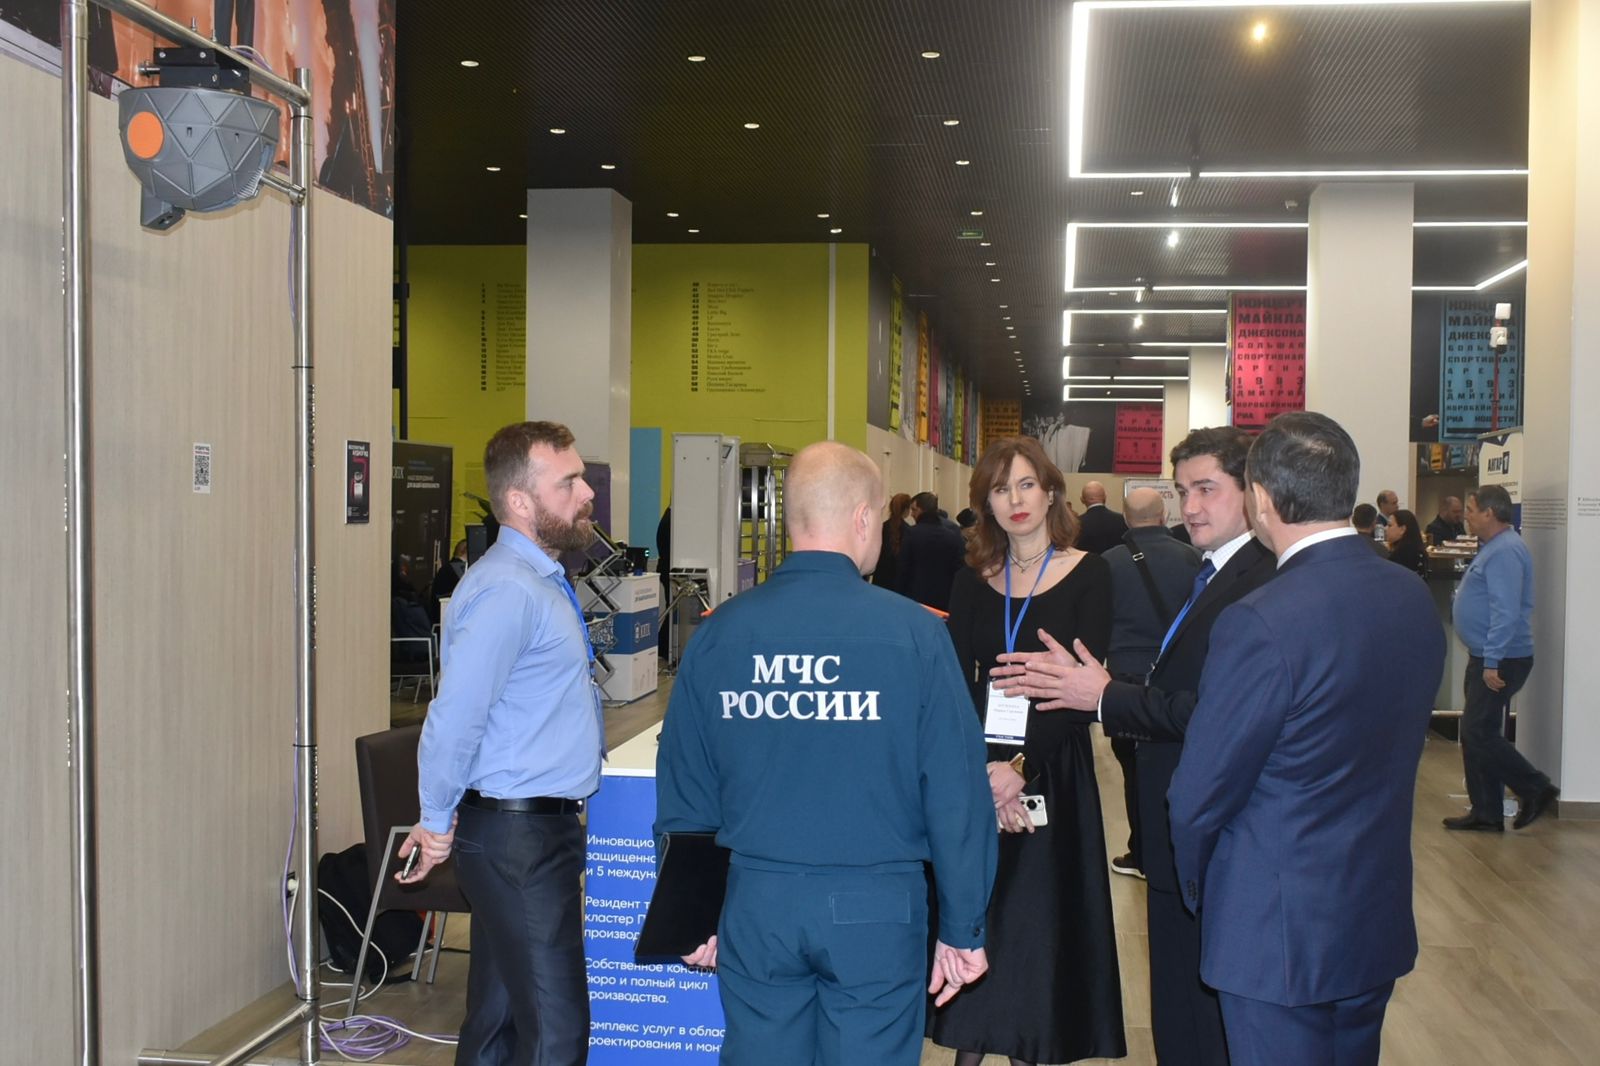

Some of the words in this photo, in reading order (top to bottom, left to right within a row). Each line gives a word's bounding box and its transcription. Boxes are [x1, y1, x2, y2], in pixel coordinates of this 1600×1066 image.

[1238, 311, 1304, 324] МАЙКЛА
[1238, 329, 1304, 339] ДЖЕКСОНА
[1237, 376, 1304, 385] 1993
[1447, 379, 1515, 388] 1993
[1236, 411, 1254, 419] РИА
[1474, 415, 1516, 423] НОВСТИ
[752, 654, 841, 685] МЧС
[719, 690, 882, 721] РОССИИ
[586, 834, 655, 849] Инновацио
[586, 867, 594, 876] и
[596, 865, 604, 877] 5
[585, 896, 641, 909] Резидент
[584, 913, 634, 926] кластер
[619, 977, 627, 986] и
[630, 977, 675, 990] полный
[679, 979, 709, 992] цикл
[588, 990, 669, 1004] роизводства.
[642, 1024, 676, 1037] услуг
[679, 1026, 686, 1036] в
[685, 1042, 693, 1052] и
[697, 1044, 722, 1054] мон
